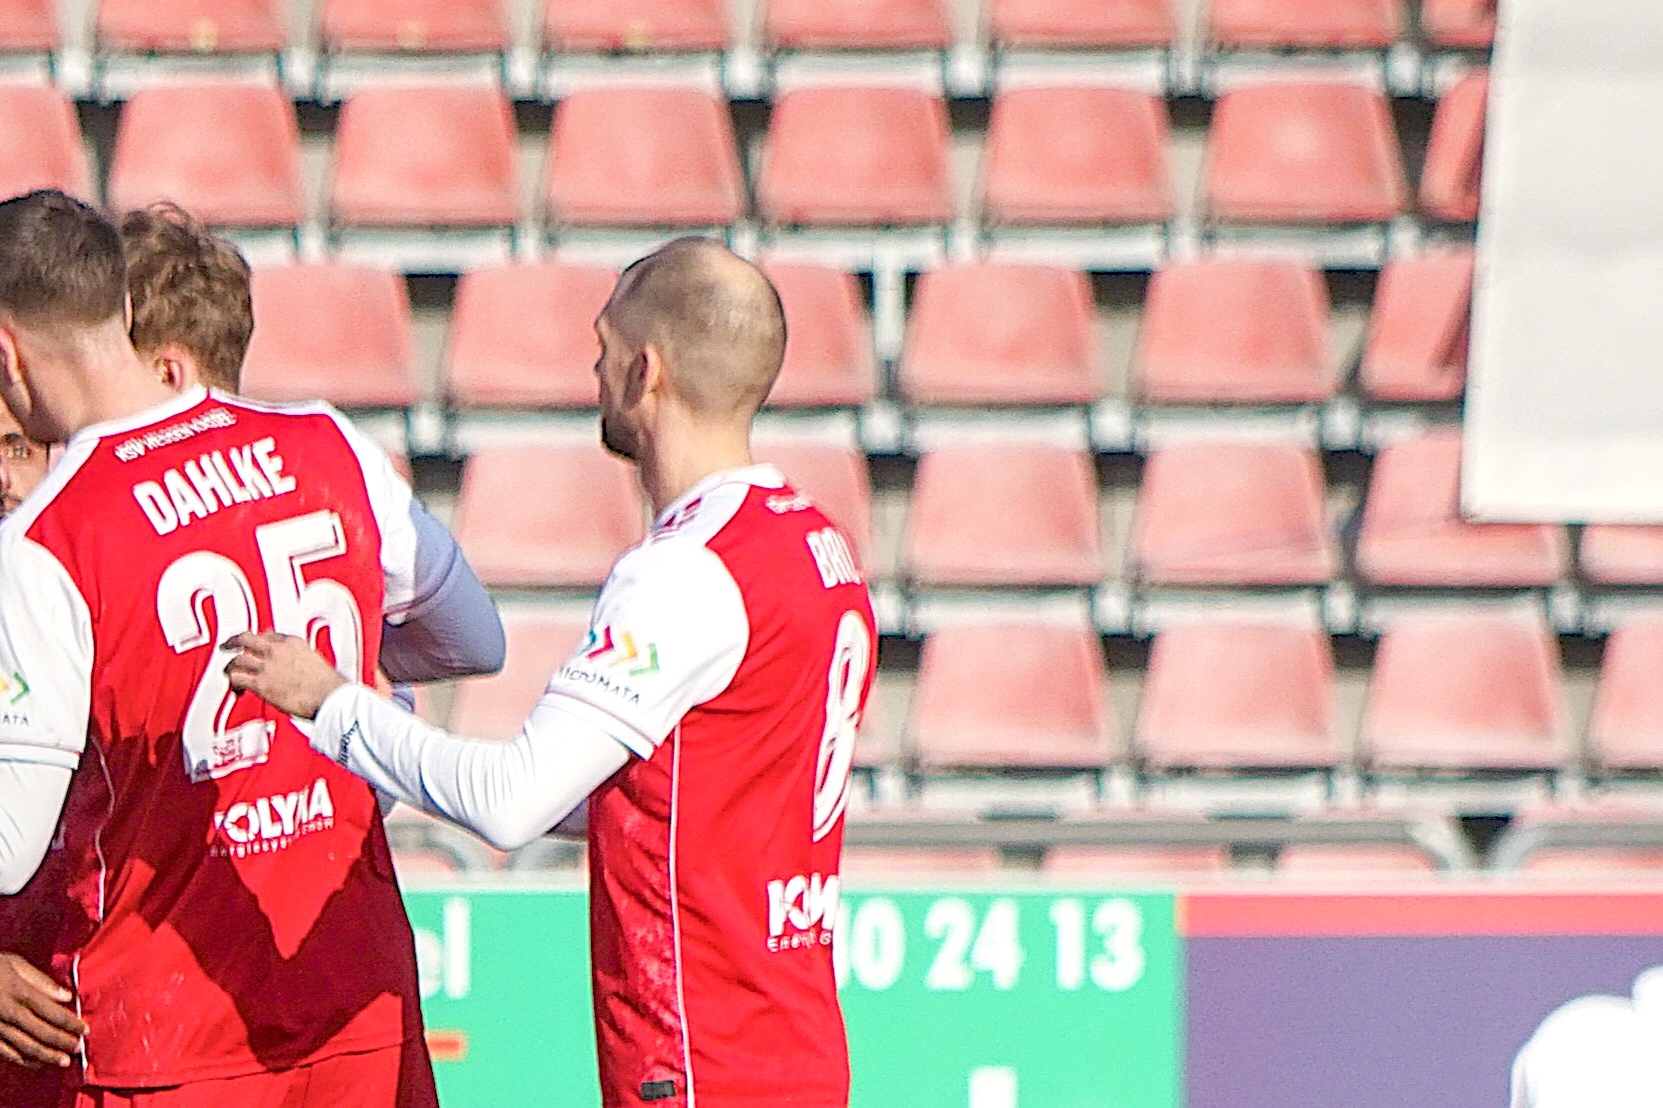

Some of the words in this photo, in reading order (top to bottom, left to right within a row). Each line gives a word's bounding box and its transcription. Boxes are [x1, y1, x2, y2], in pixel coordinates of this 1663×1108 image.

[133, 436, 297, 536] DAHLKE
[157, 510, 364, 783] 25
[812, 610, 870, 842] 8
[833, 896, 906, 991] 0
[925, 897, 1029, 991] 24
[1049, 897, 1146, 992] 13
